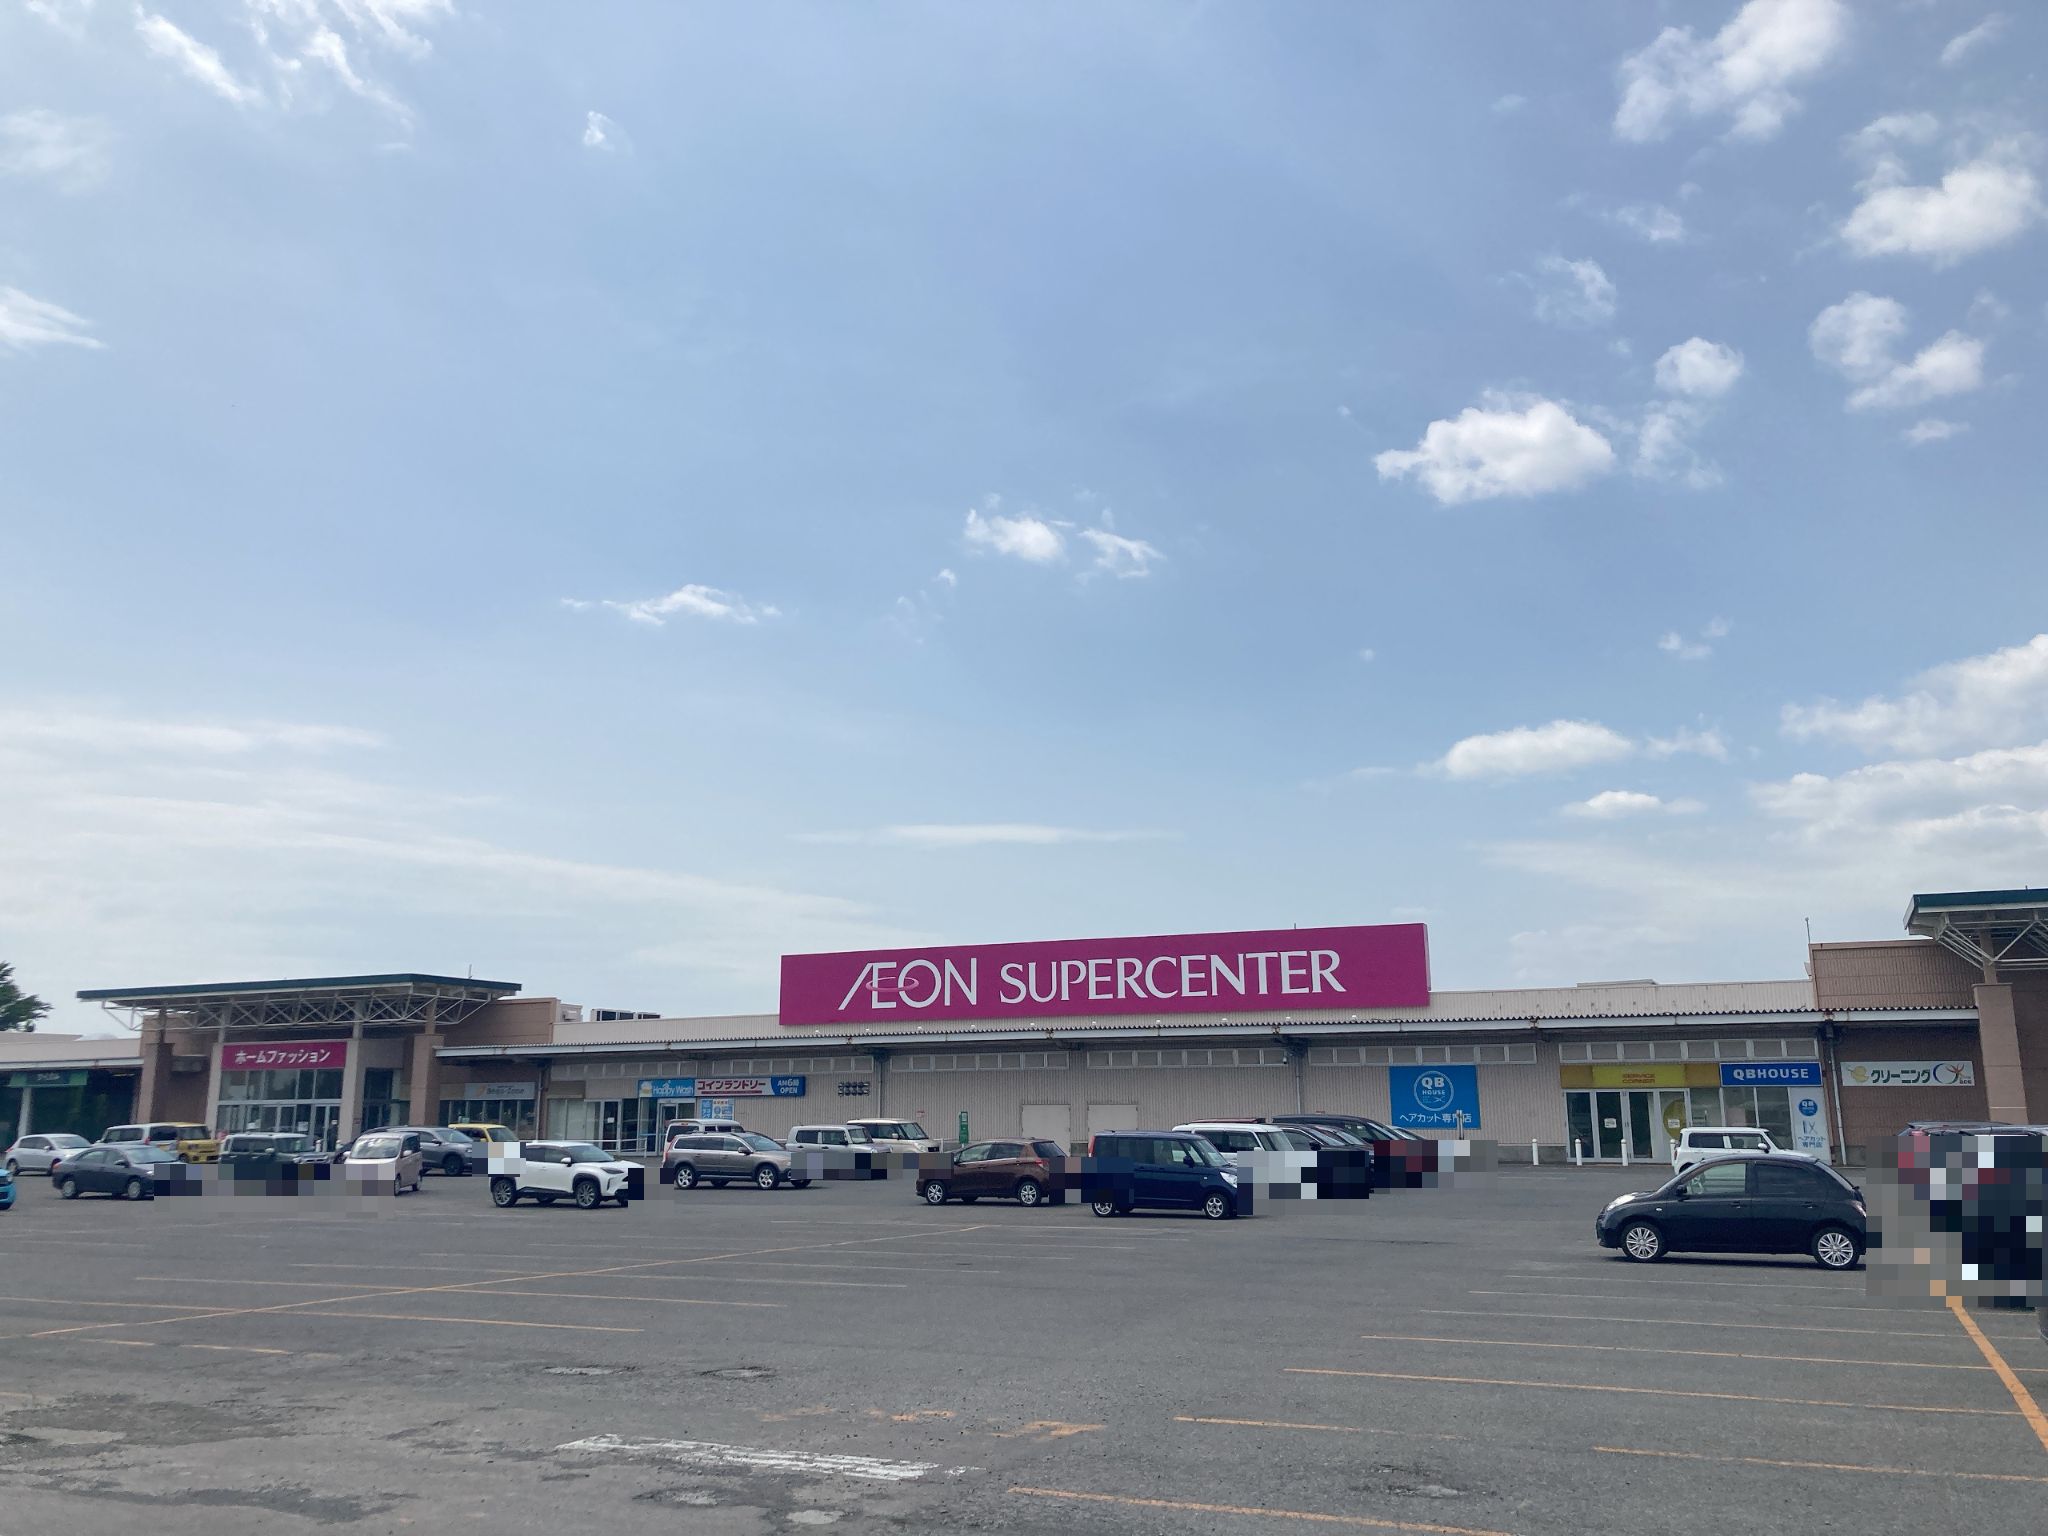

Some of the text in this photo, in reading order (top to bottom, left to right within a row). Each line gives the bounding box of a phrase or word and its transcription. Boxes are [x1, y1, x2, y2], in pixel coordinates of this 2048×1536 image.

[1000, 950, 1346, 1004] SUPERCENTER
[235, 1049, 331, 1065] ホームファッション
[1421, 1077, 1445, 1089] QB
[1870, 1069, 1931, 1084] クリーニング
[676, 1085, 694, 1094] Wash
[697, 1079, 766, 1091] コインランドリー
